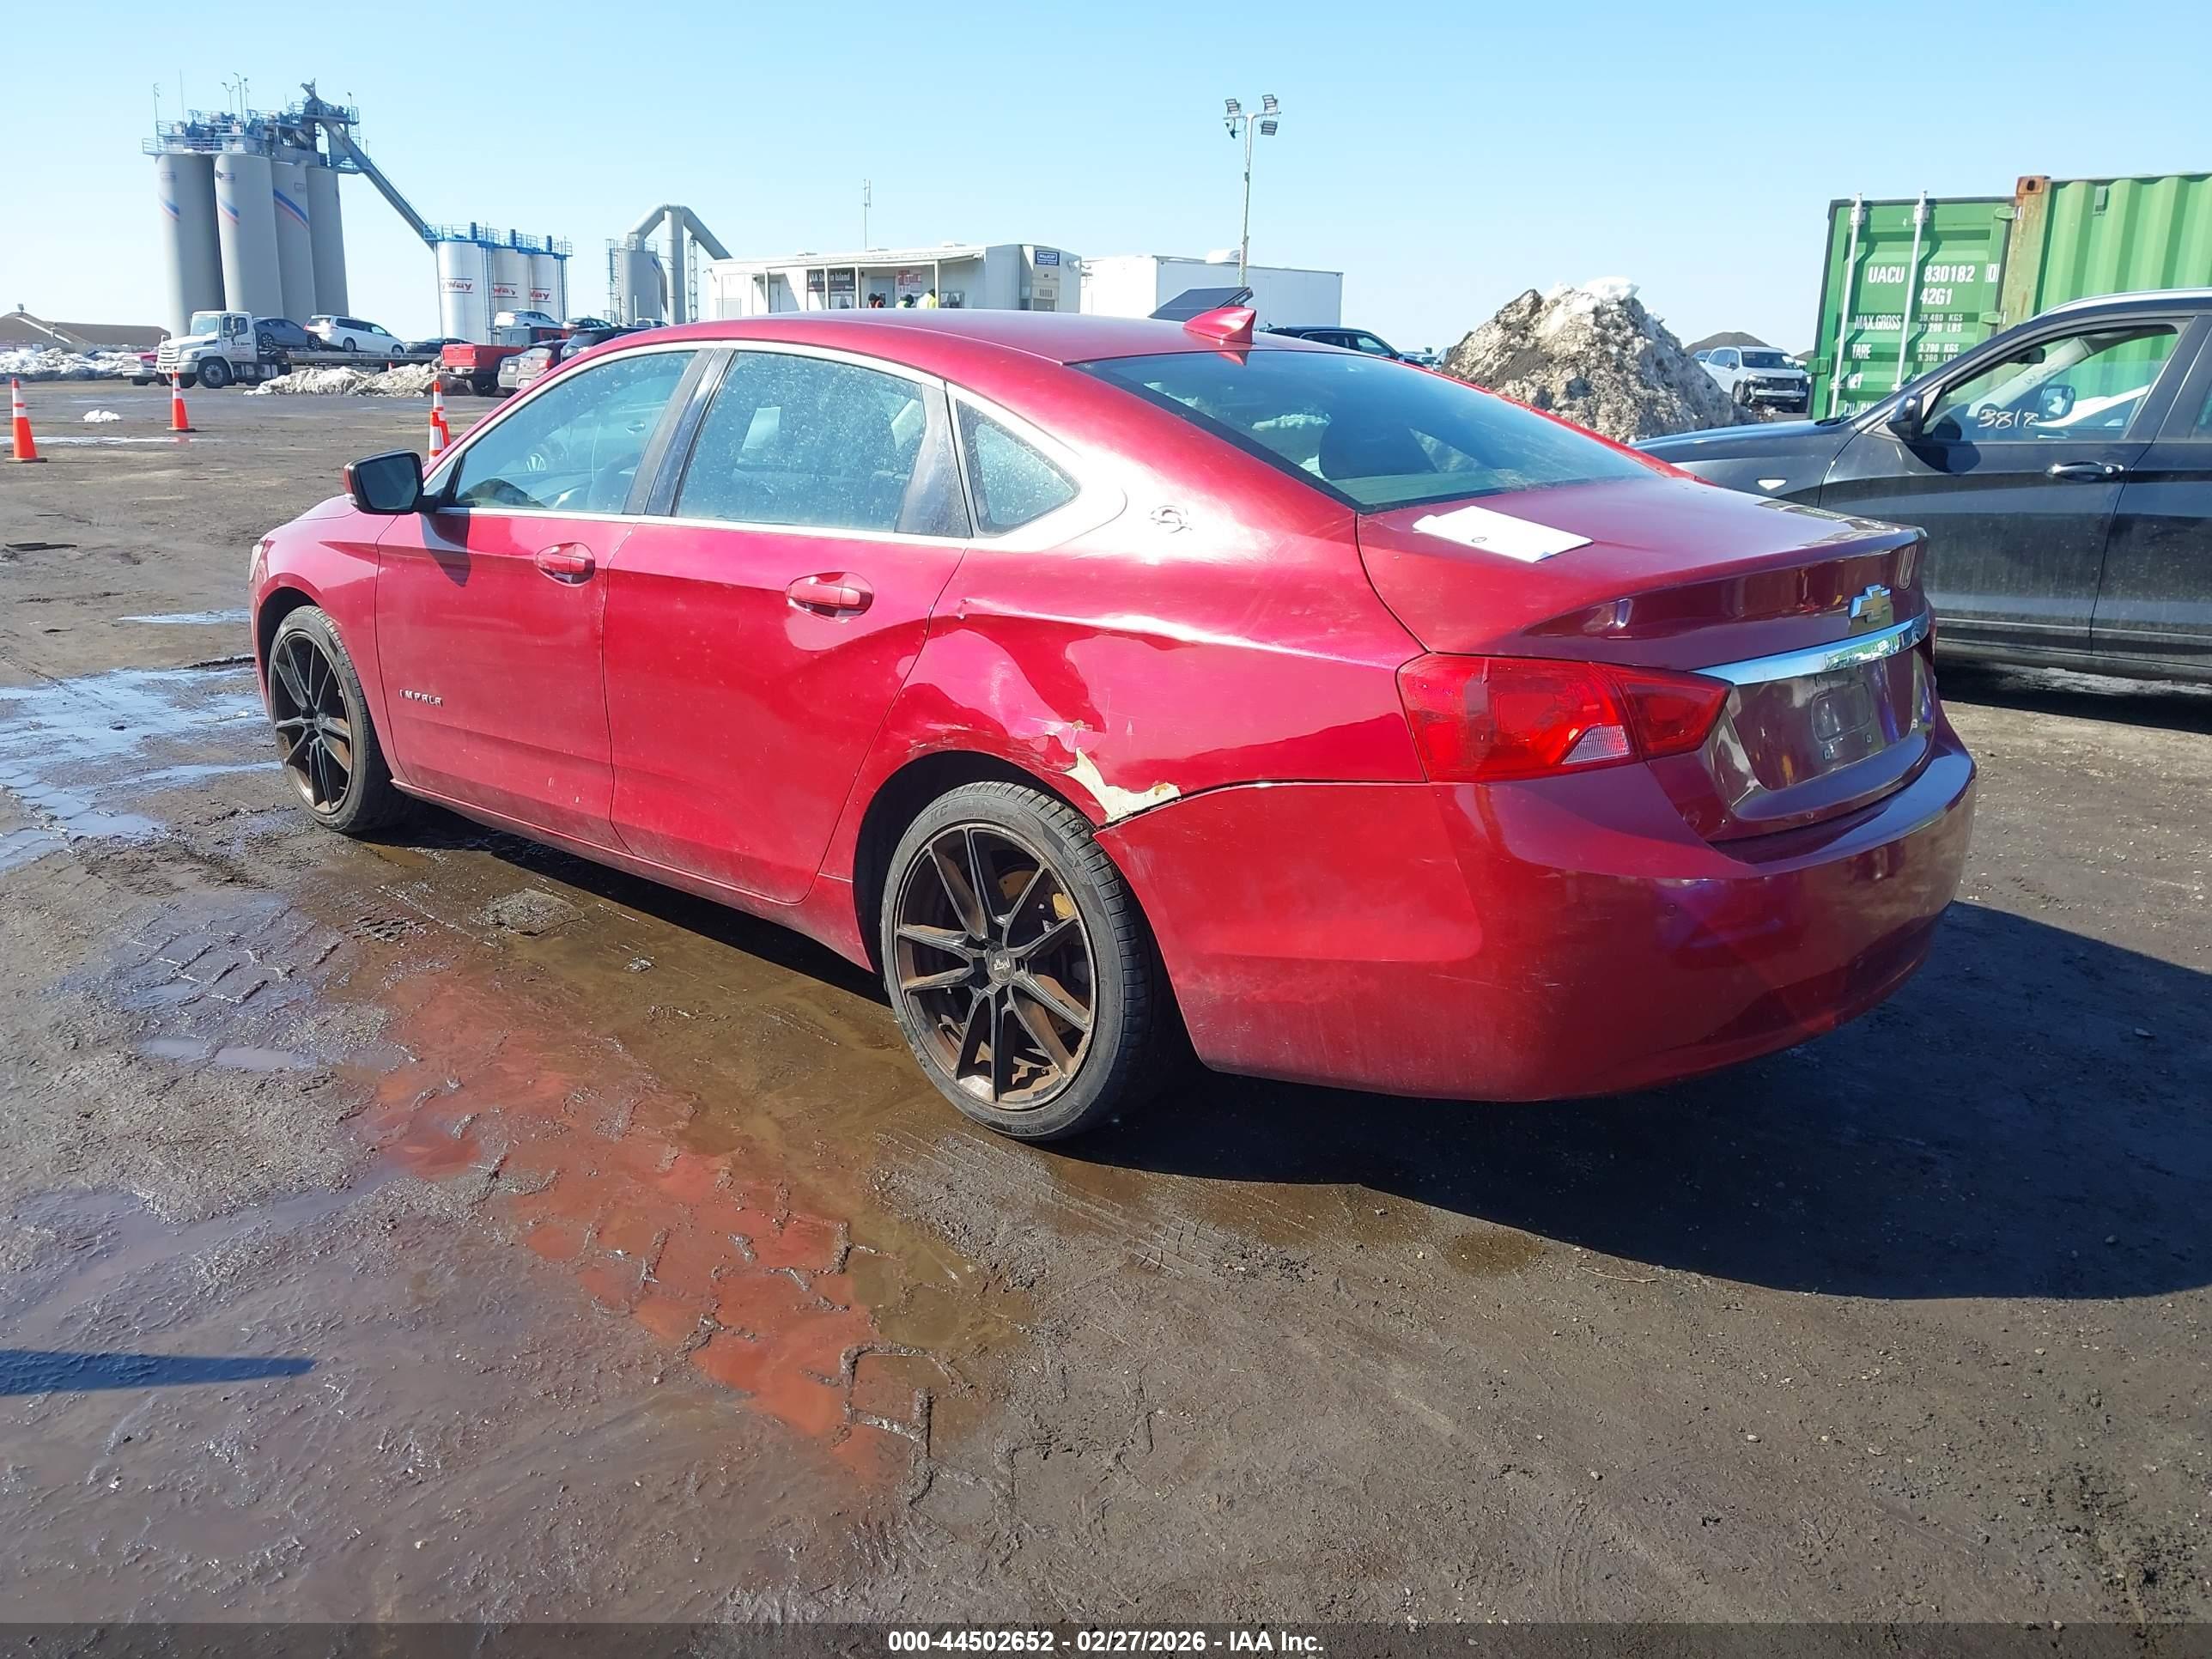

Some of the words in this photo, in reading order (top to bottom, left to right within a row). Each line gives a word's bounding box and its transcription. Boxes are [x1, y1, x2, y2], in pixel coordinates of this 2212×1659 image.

[836, 271, 851, 281] Island
[1869, 266, 1905, 283] UACU
[1923, 265, 1976, 283] 830182
[1919, 288, 1953, 305] 42G1
[1948, 313, 1964, 322] KGS
[1947, 324, 1962, 332] LBS
[1852, 343, 1872, 360] TARE
[1944, 343, 1960, 353] KGS
[398, 689, 443, 708] IMPALA
